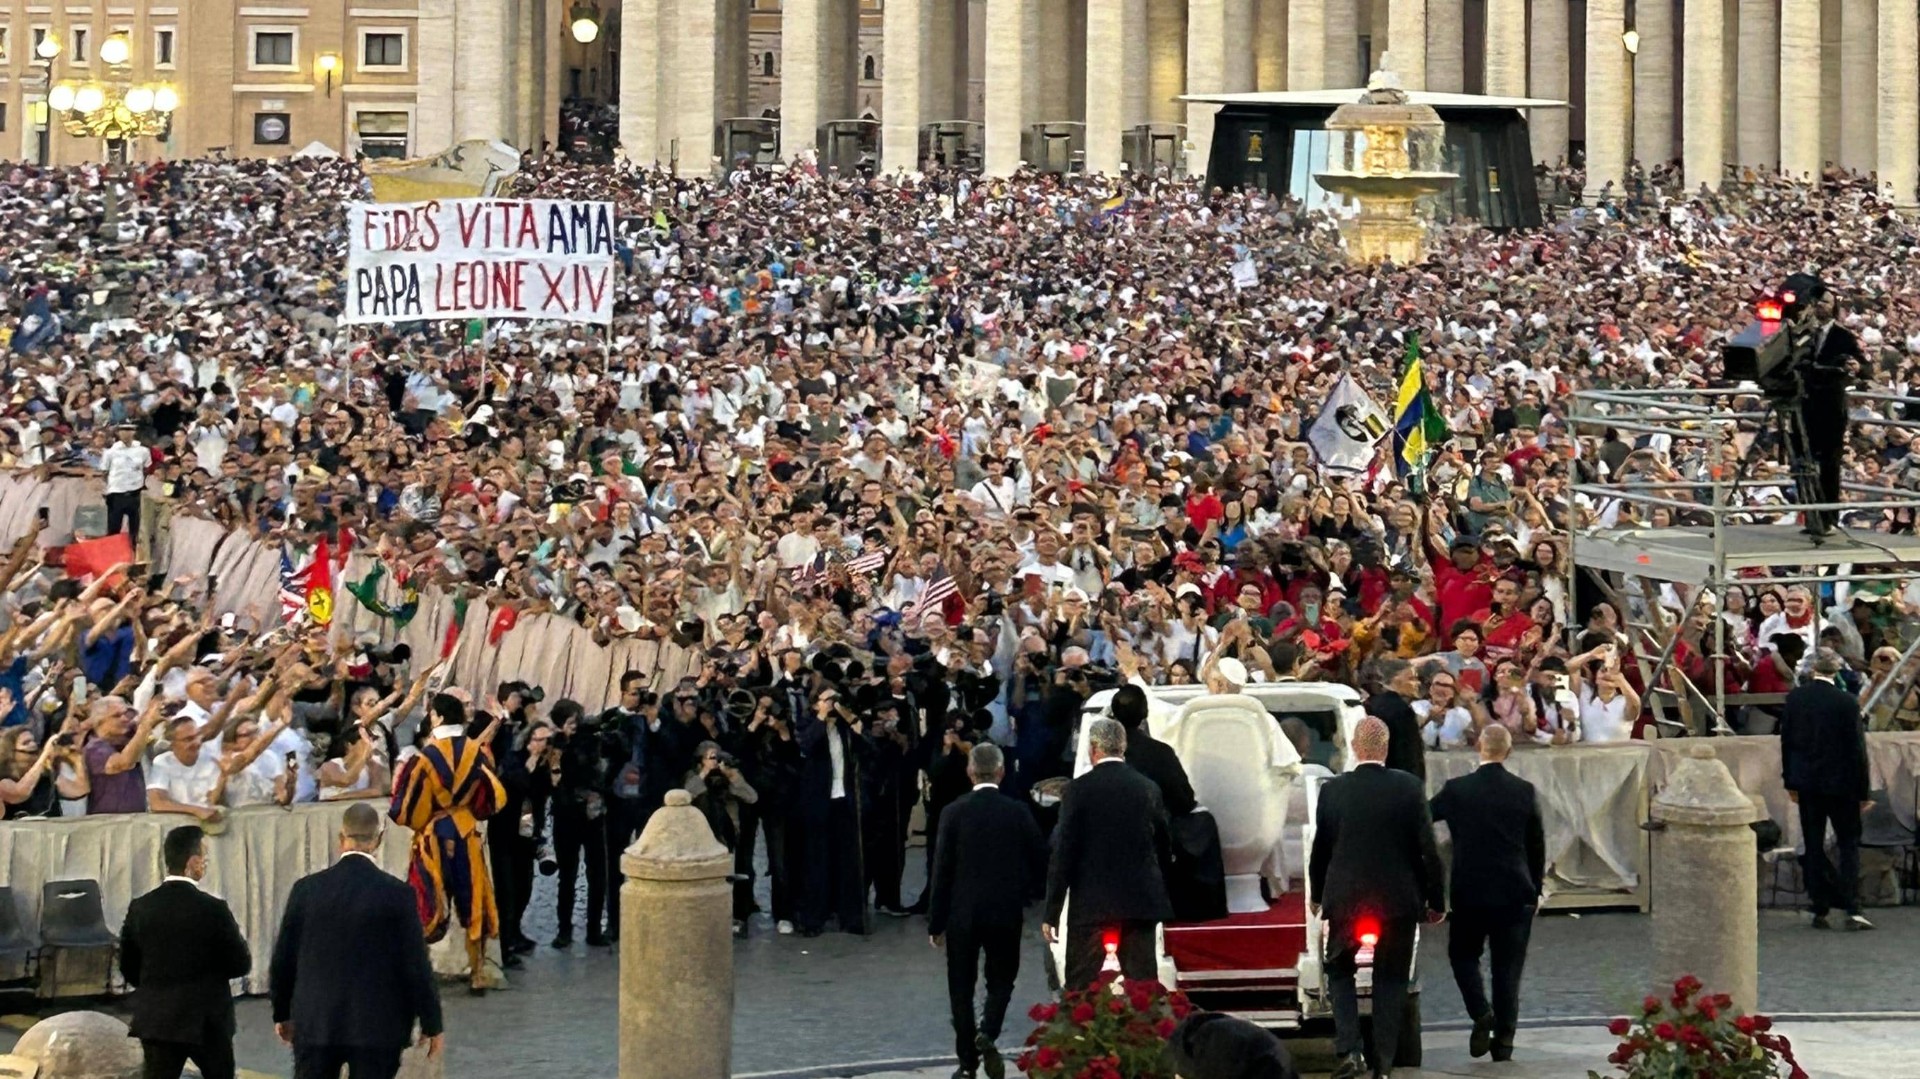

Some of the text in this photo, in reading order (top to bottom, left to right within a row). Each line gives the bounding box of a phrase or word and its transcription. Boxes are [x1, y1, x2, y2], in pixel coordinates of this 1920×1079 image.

[546, 203, 613, 255] AMA
[357, 260, 609, 316] PAPA LEONE XIV
